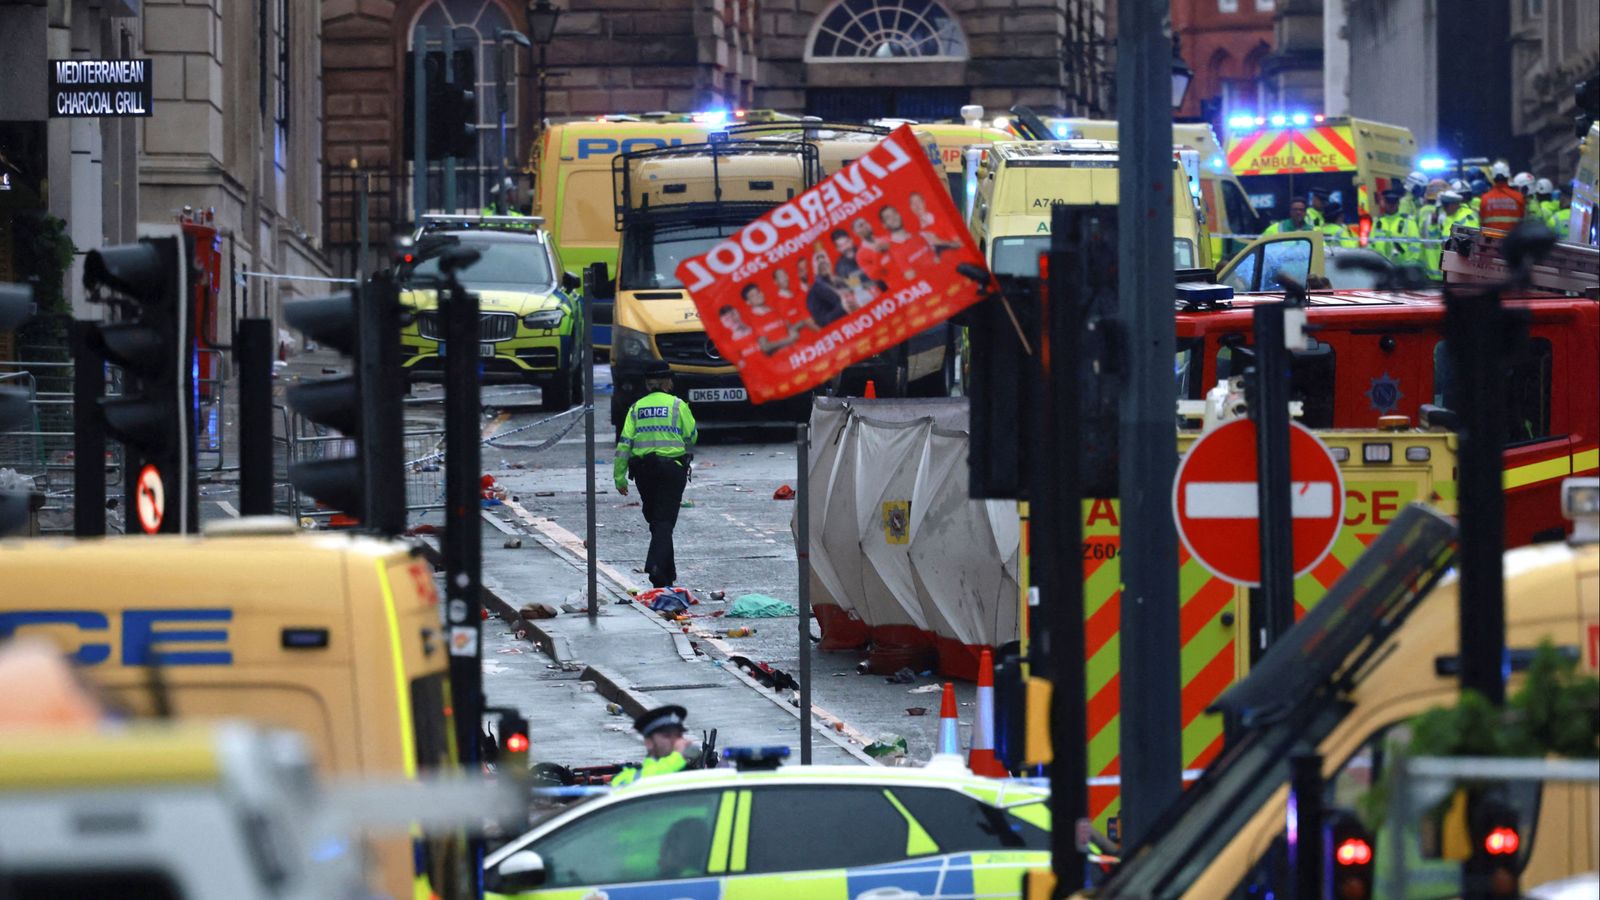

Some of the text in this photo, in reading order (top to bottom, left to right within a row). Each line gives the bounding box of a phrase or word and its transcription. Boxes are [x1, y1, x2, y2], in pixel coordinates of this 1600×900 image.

[56, 61, 144, 83] MEDITERRANEAN
[57, 91, 145, 114] CHARCOAL GRILL
[1251, 154, 1337, 168] AMBULANCE
[693, 389, 720, 401] DK65
[640, 408, 667, 417] POLICE
